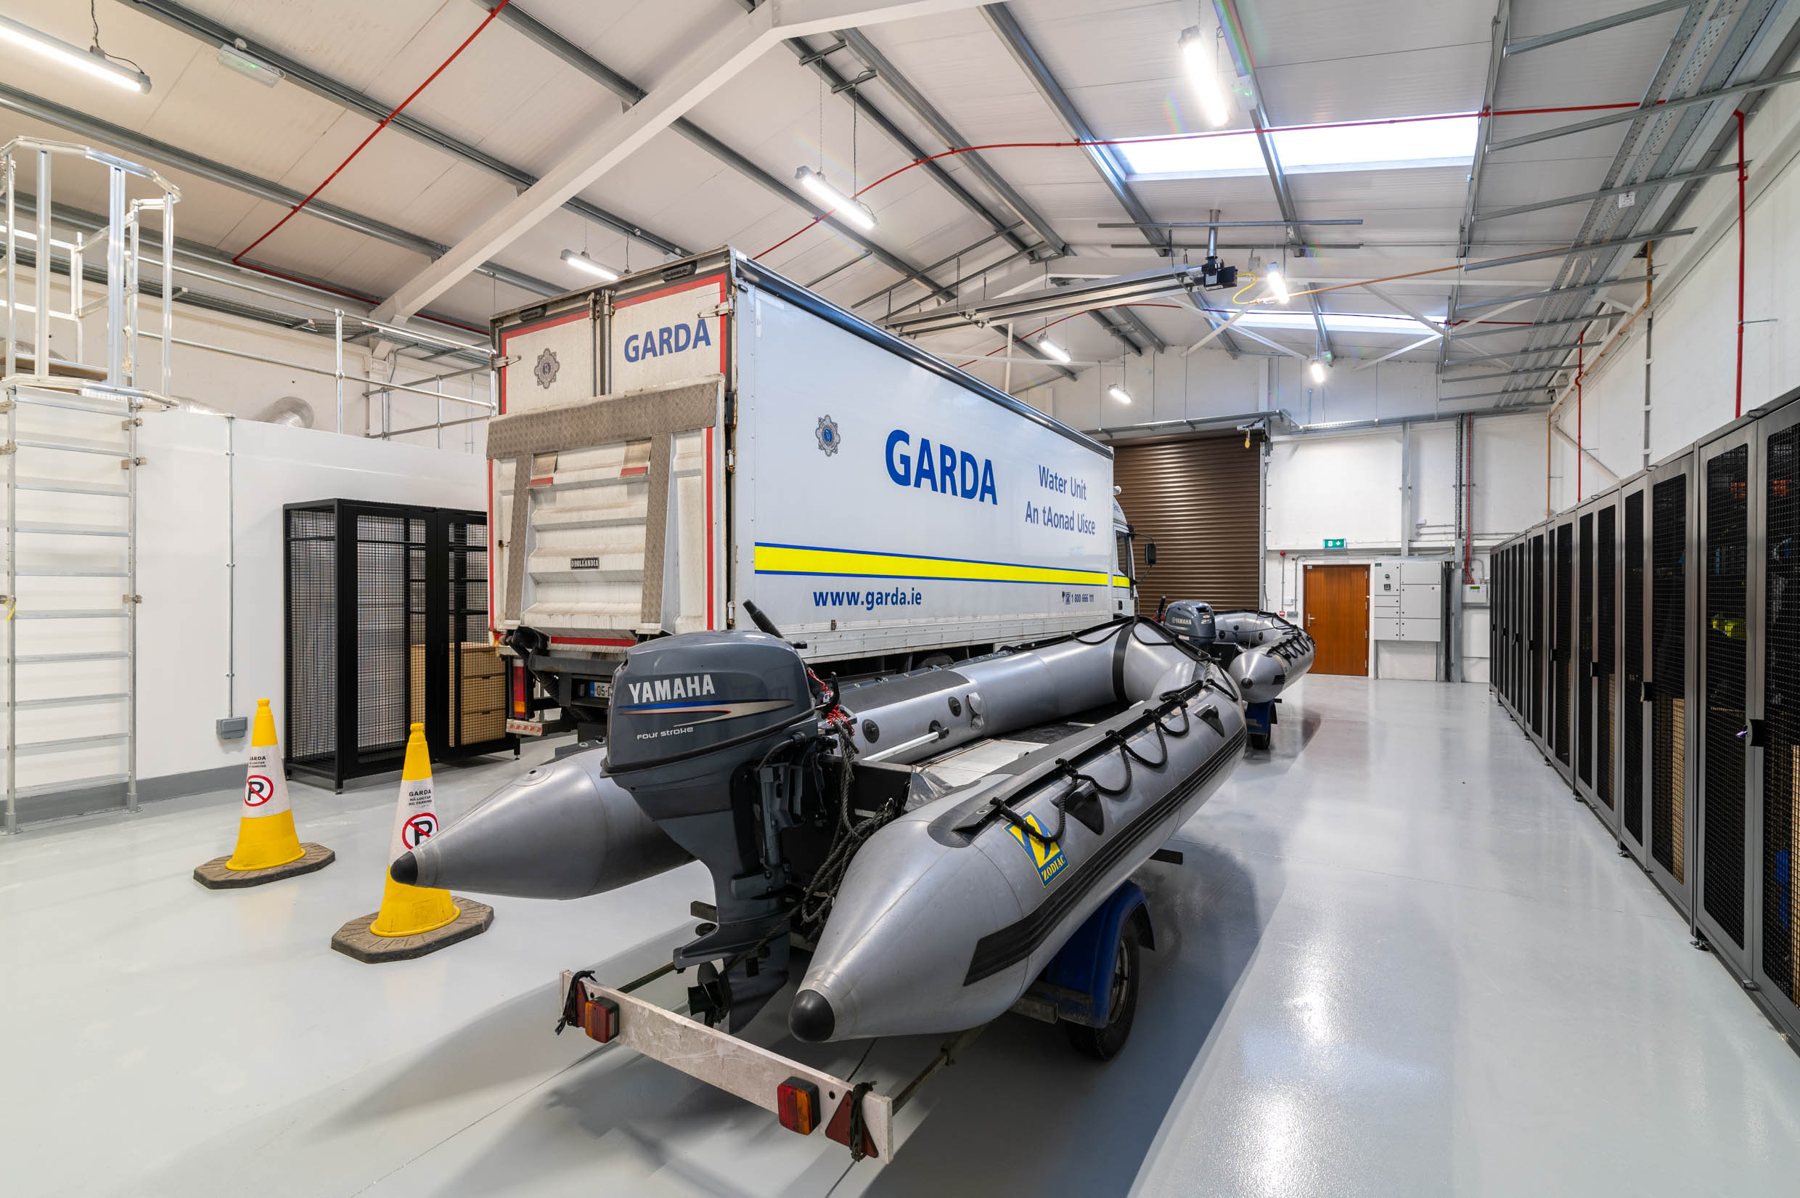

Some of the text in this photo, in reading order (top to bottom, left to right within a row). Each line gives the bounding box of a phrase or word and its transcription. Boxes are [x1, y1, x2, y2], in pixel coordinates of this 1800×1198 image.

[624, 318, 712, 363] GARDA
[885, 429, 998, 506] GARDA
[1038, 464, 1087, 501] Water Unit
[1025, 500, 1096, 536] An tAonad Uisce
[813, 587, 922, 611] www.garda.ie
[628, 673, 716, 705] YAMAHA
[408, 789, 431, 797] GARDA
[1041, 854, 1066, 881] ZODIAC
